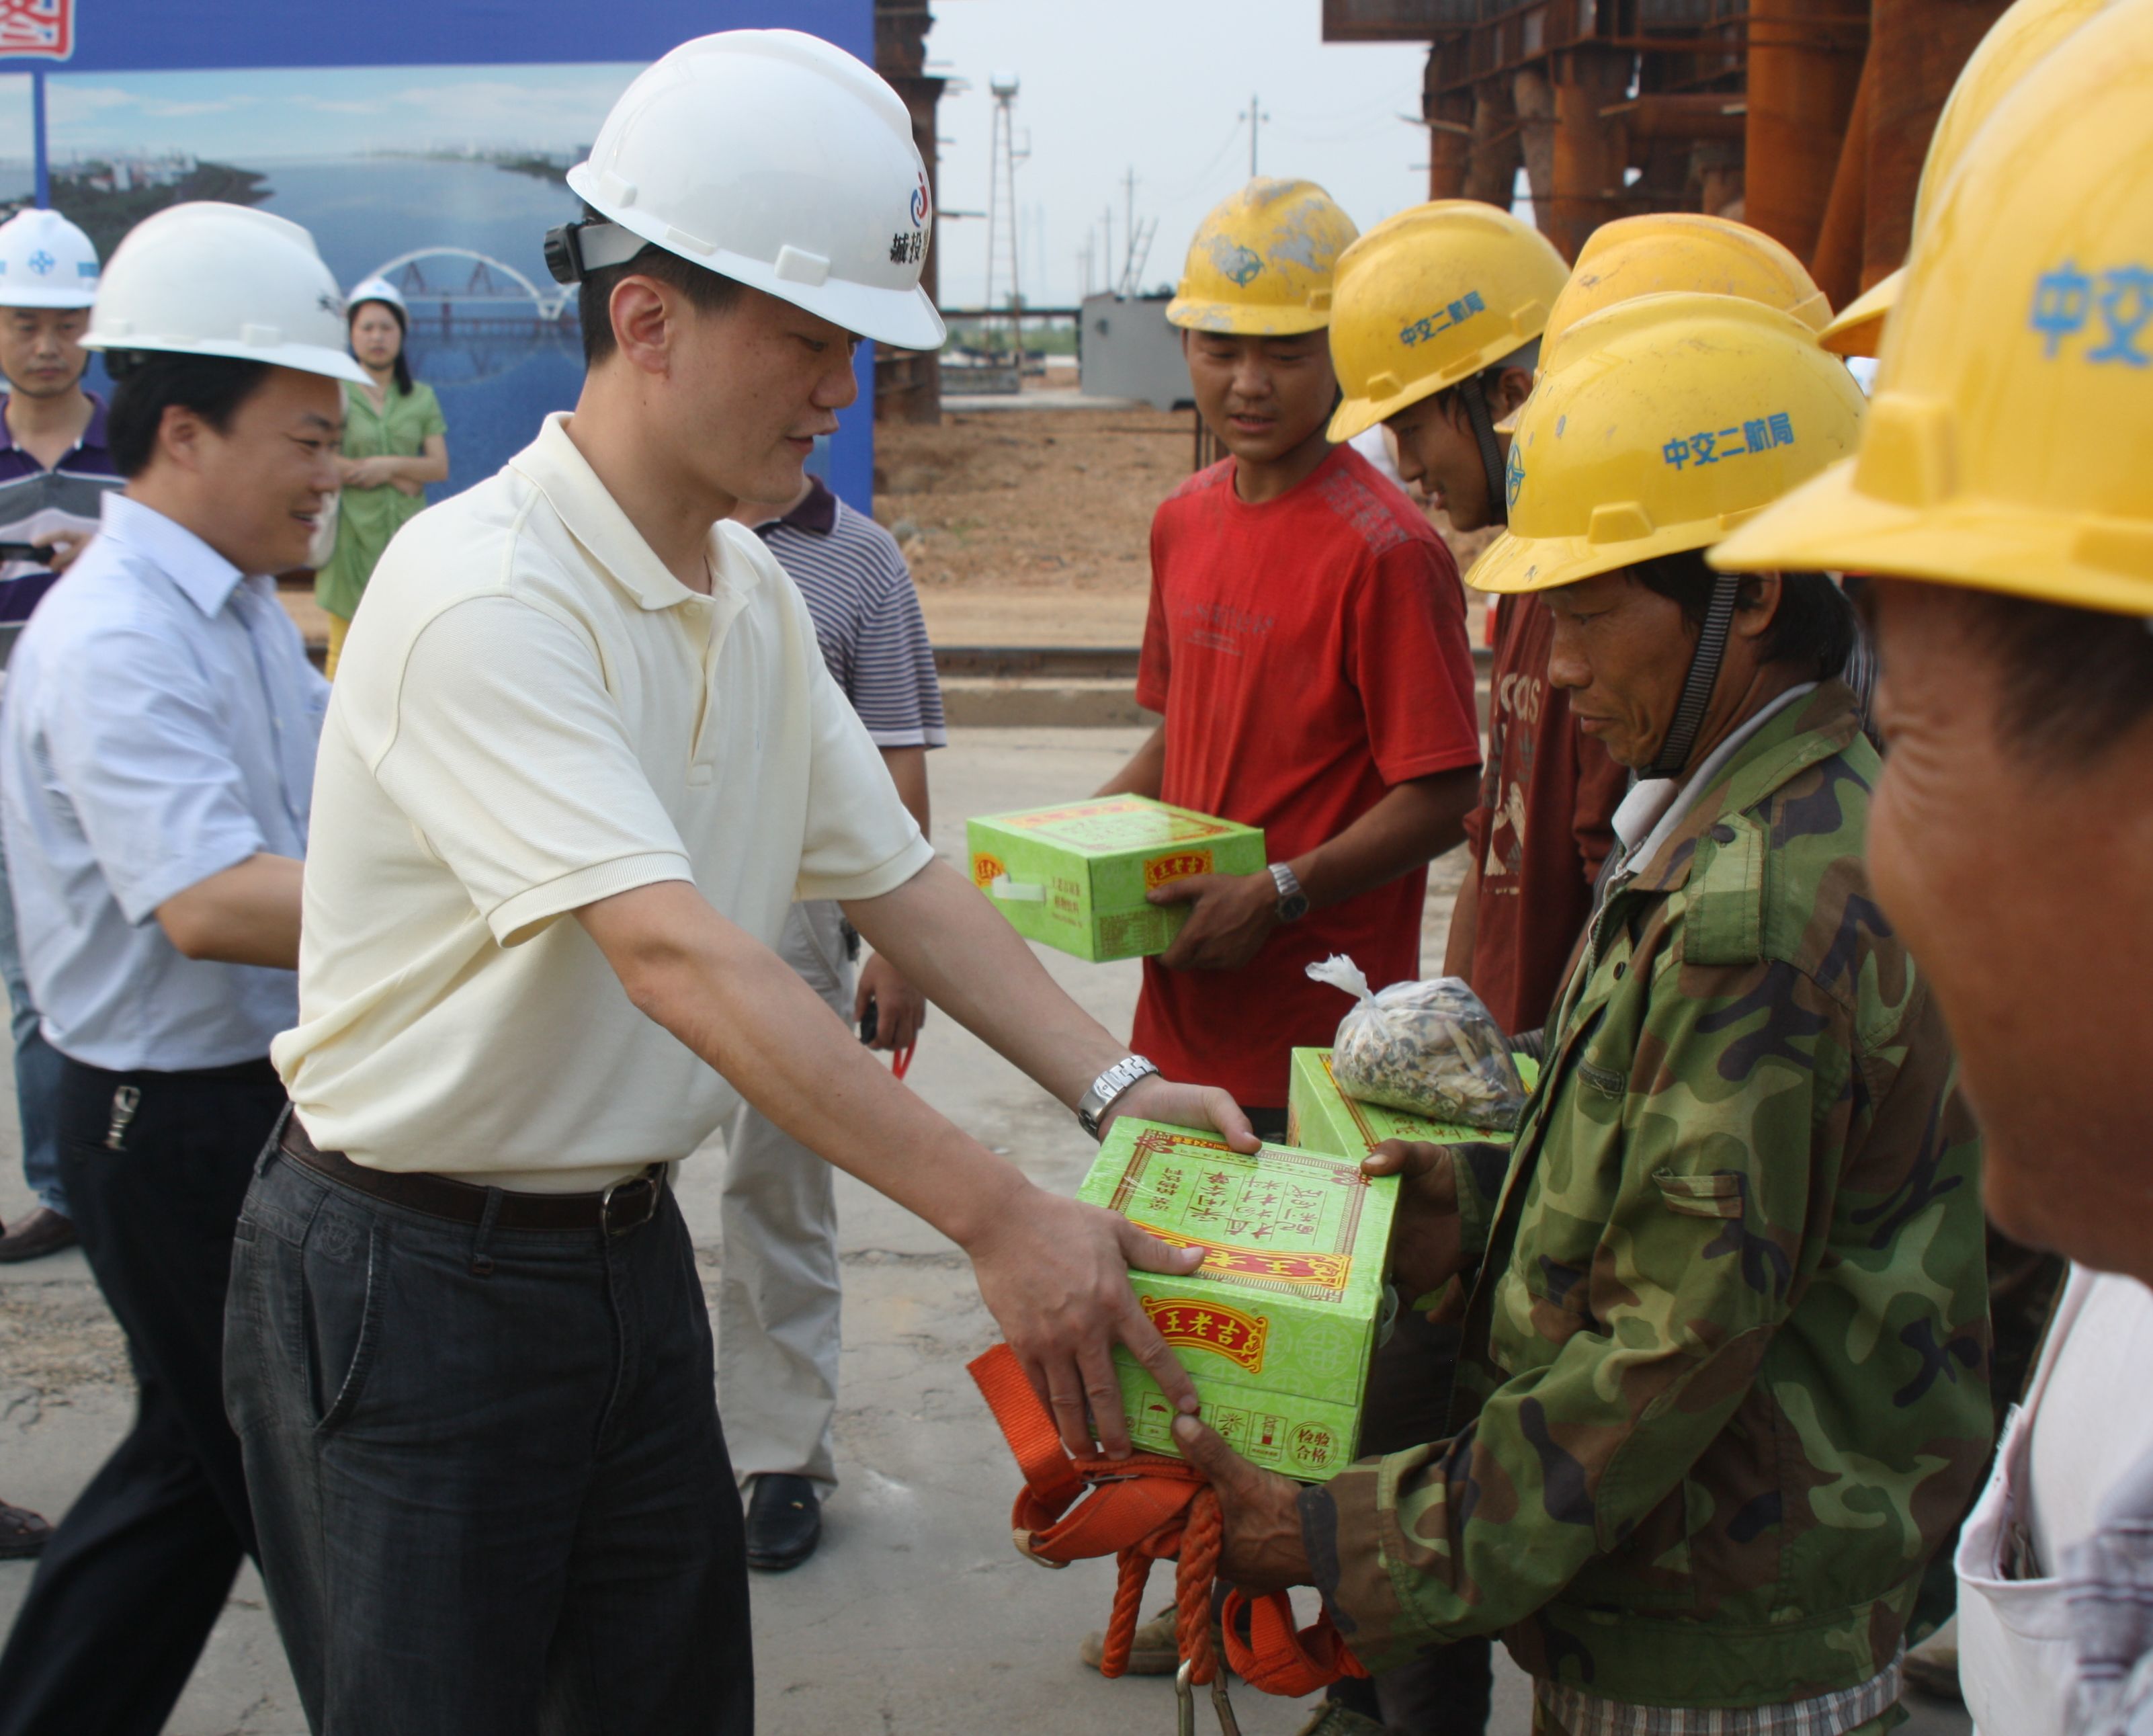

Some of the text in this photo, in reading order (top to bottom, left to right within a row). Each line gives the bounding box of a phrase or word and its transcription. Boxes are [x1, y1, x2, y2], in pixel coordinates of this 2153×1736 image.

[1662, 412, 1794, 470] 中交二航局
[1163, 1311, 1241, 1345] 王老吉
[1298, 1428, 1331, 1447] 检验
[1296, 1445, 1326, 1464] 合格
